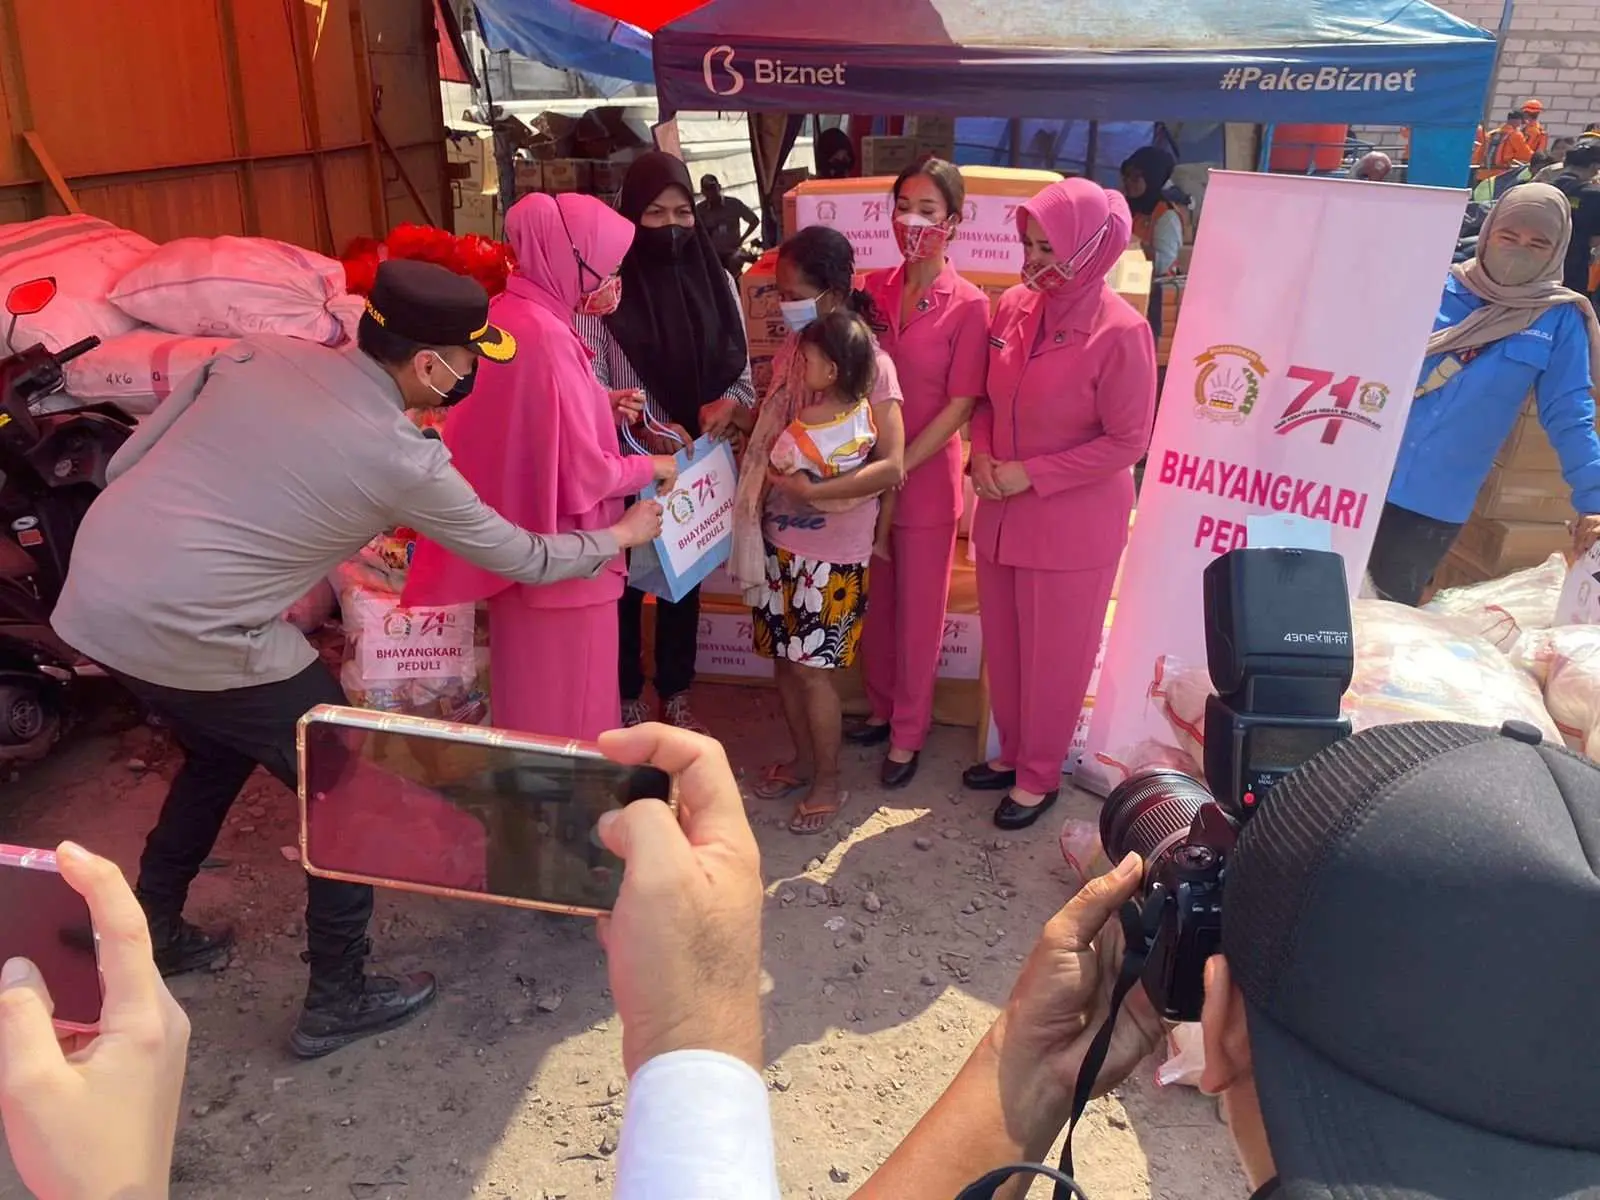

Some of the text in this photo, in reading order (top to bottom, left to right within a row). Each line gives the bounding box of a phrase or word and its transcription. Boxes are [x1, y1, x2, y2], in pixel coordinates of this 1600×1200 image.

[755, 59, 846, 85] Biznet
[1220, 67, 1416, 92] #PakeBiznet
[1278, 364, 1361, 445] 71
[1158, 450, 1368, 529] BHAYANGKARI
[677, 497, 734, 550] BHAYANGKARI
[696, 520, 725, 550] PEDULI
[376, 647, 463, 659] BHAYANGKARI
[397, 661, 441, 672] PEDULI
